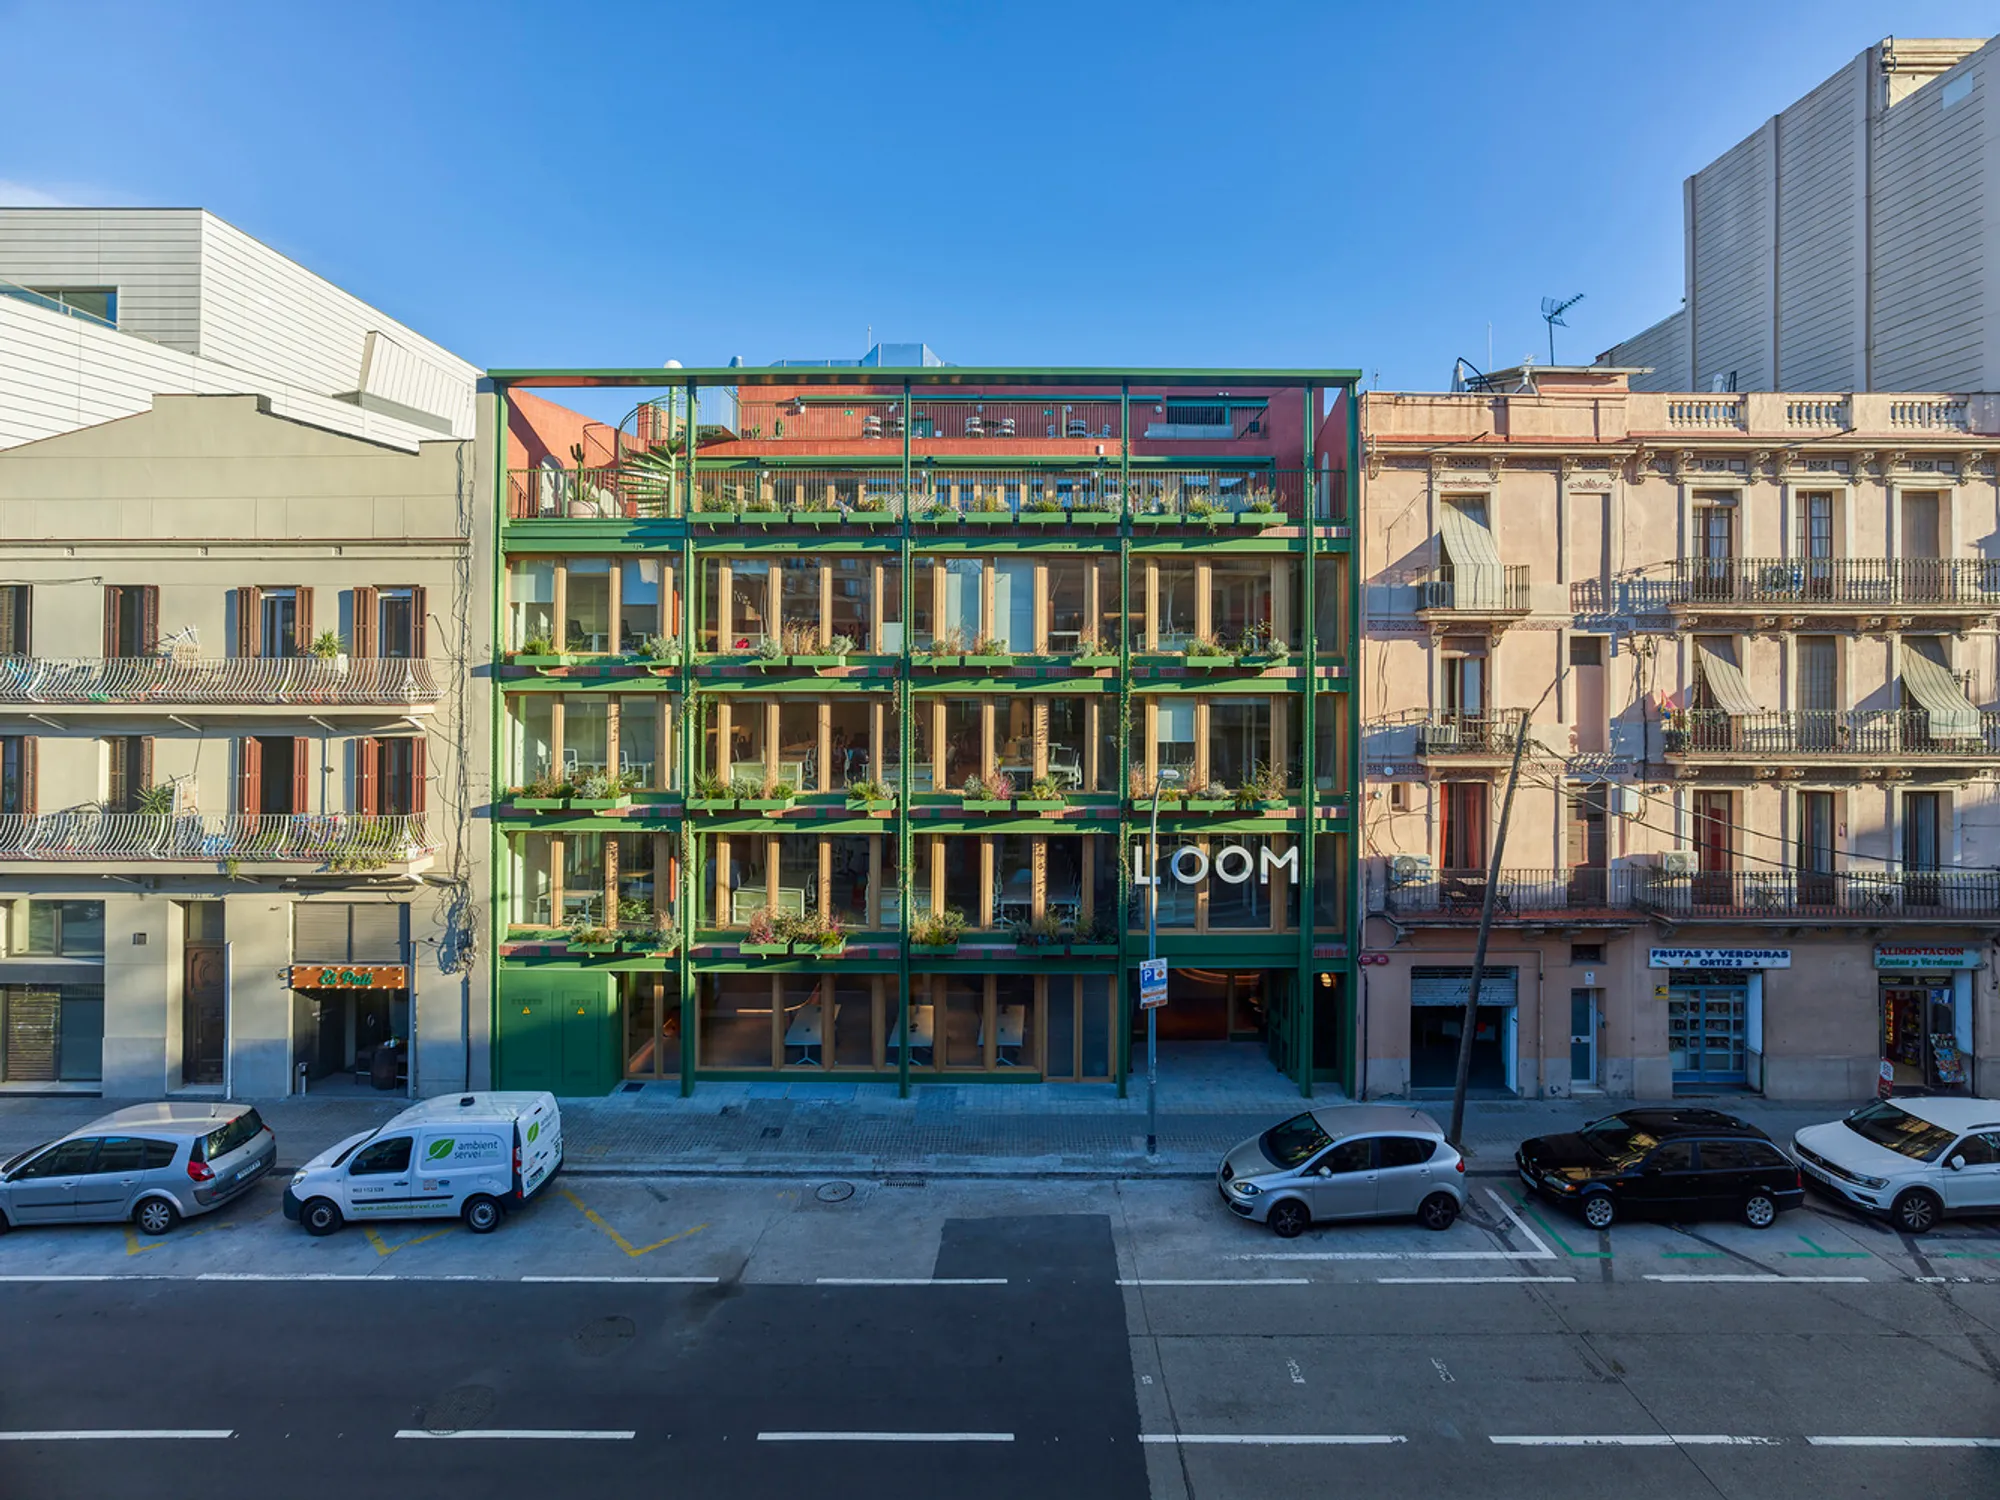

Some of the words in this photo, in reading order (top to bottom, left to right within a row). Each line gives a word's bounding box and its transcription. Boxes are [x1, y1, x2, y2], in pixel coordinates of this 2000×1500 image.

[1134, 845, 1299, 885] LOOM
[1652, 950, 1701, 958] FRUTAS
[1706, 950, 1716, 958] Y
[1717, 950, 1789, 959] VERDURAS
[1699, 958, 1733, 967] ORTIZ
[1735, 959, 1743, 967] 2
[320, 969, 338, 985] El
[341, 970, 374, 986] Pati
[1144, 970, 1152, 981] P
[457, 1140, 498, 1151] ambient
